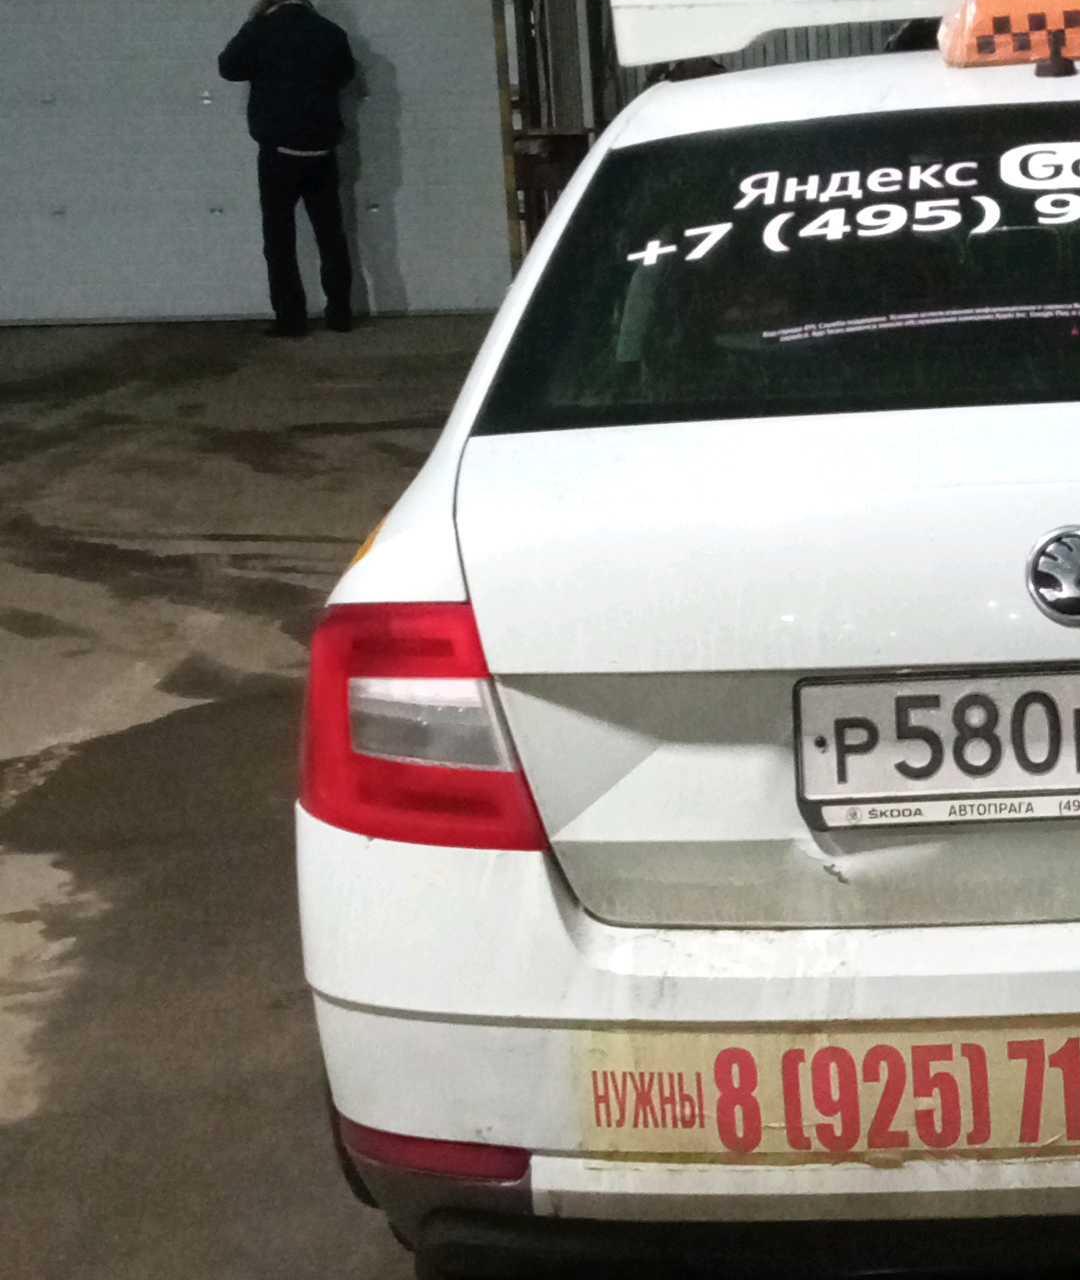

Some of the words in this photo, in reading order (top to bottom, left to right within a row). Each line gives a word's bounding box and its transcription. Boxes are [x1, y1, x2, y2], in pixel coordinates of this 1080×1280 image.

[733, 161, 978, 210] Яндекс
[626, 222, 733, 266] +7
[762, 195, 1001, 252] (495)
[948, 801, 1034, 817] АВТОПРАГА
[591, 1068, 706, 1130] НУЖНЫ
